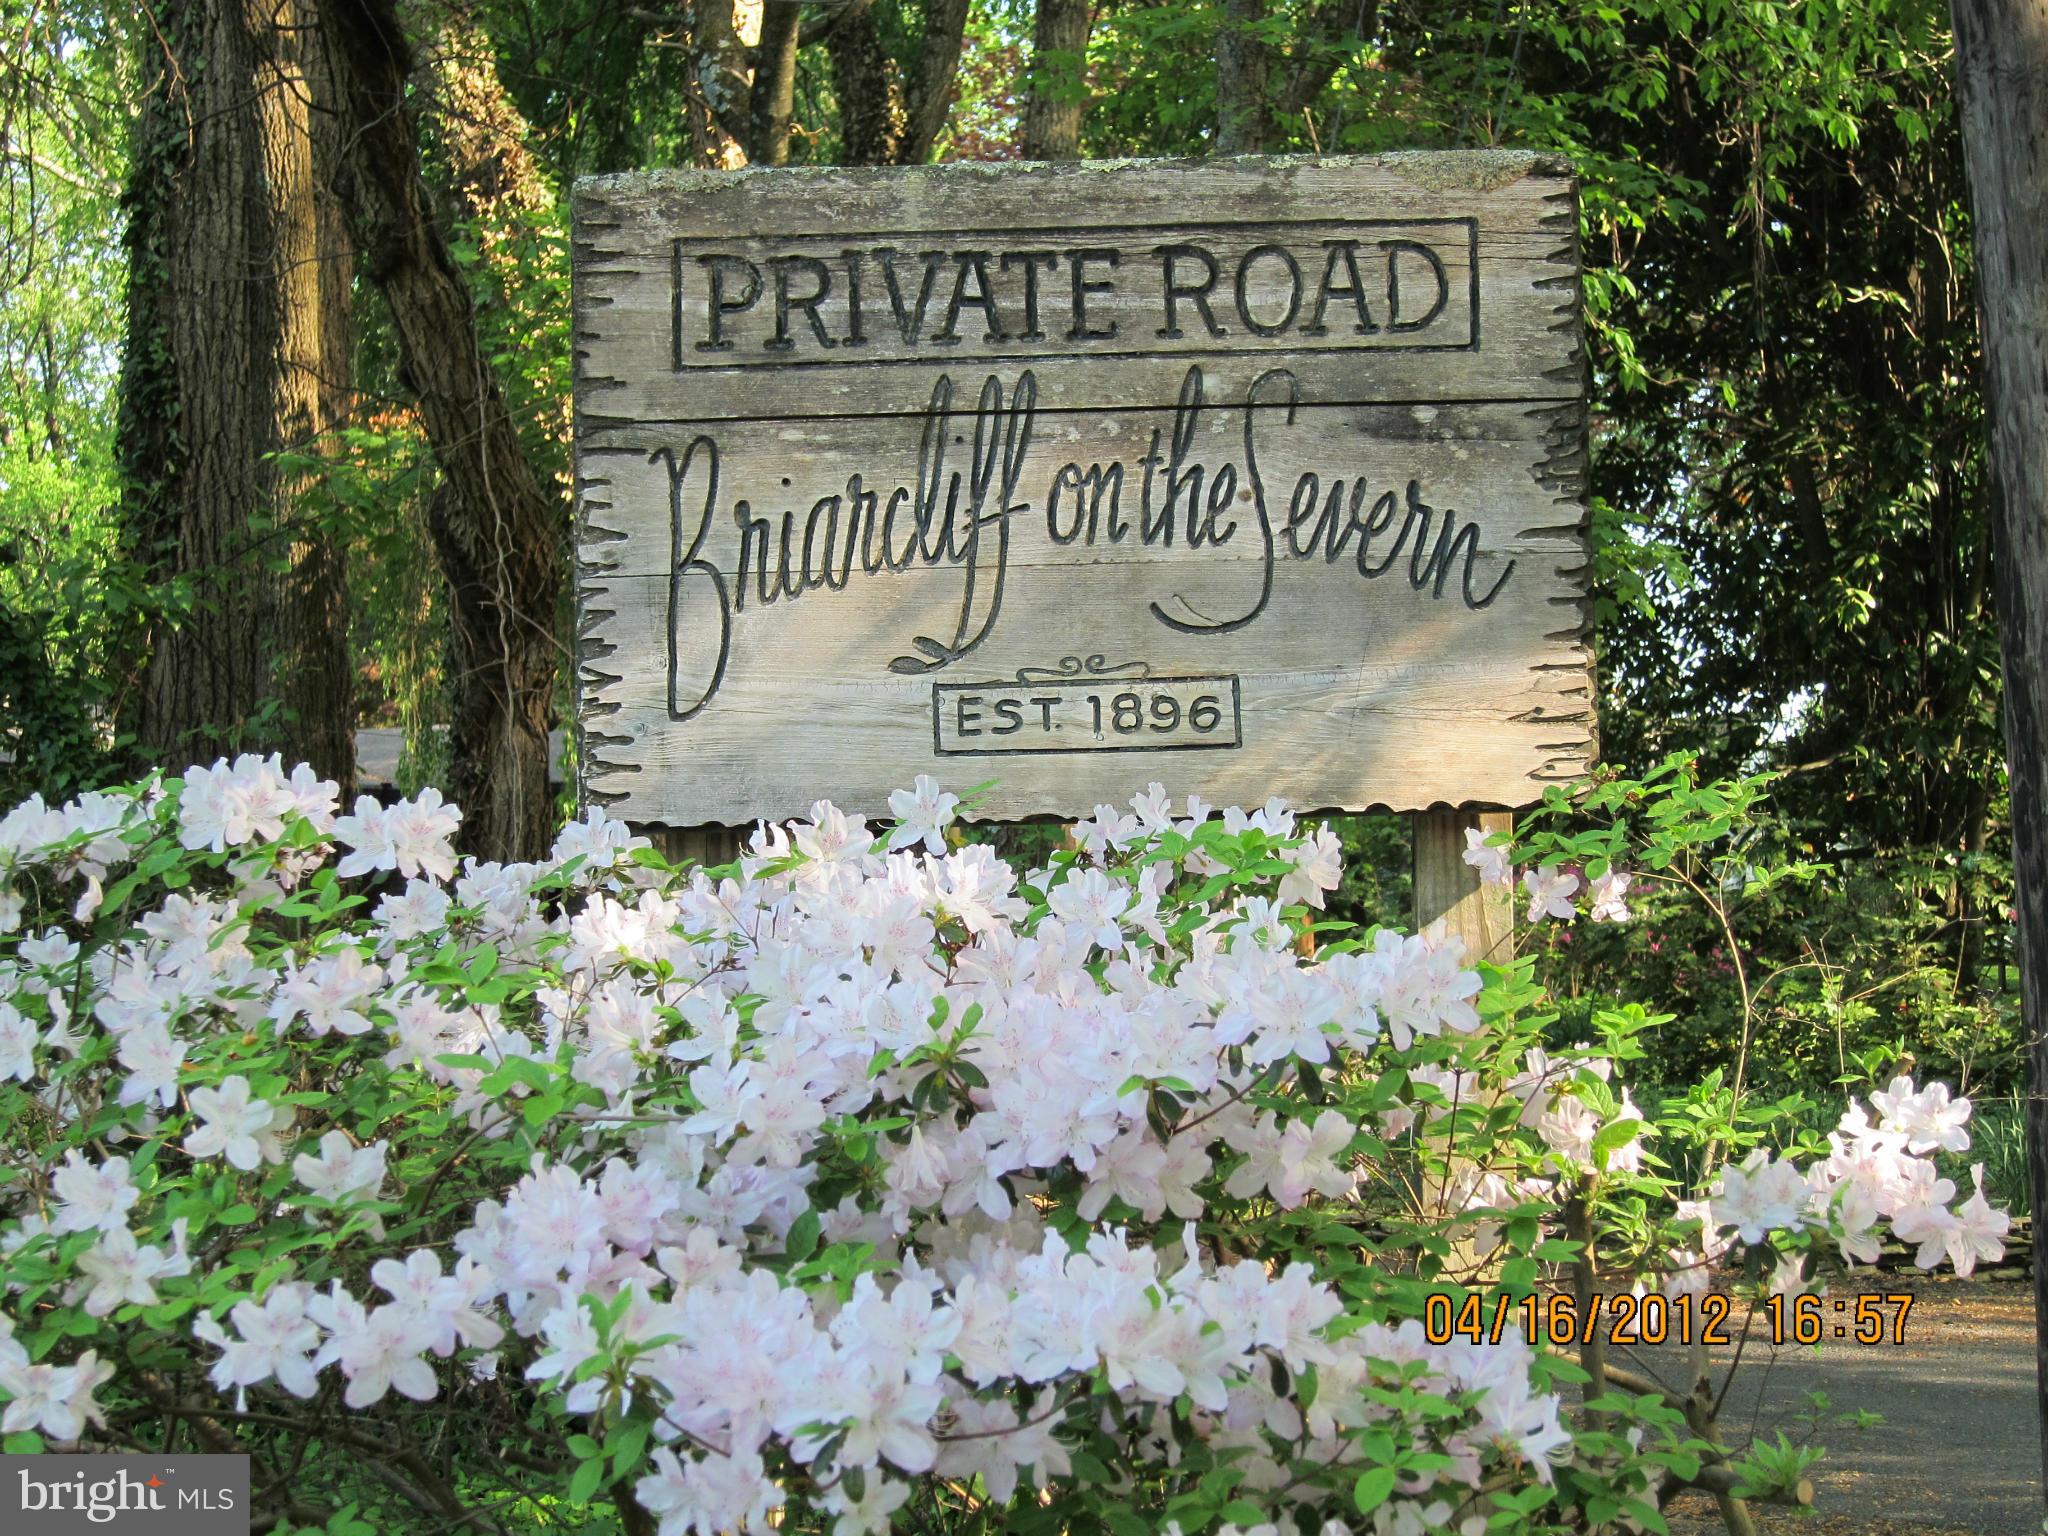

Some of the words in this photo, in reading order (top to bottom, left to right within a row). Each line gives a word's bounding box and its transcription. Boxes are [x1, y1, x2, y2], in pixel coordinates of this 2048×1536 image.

[695, 247, 1119, 353] PRIVATE
[1154, 239, 1449, 340] ROAD
[1045, 460, 1130, 545] on
[1138, 364, 1238, 549] the
[1150, 368, 1516, 635] Severn
[648, 369, 1038, 722] Briarcliff
[1087, 693, 1222, 735] 1896
